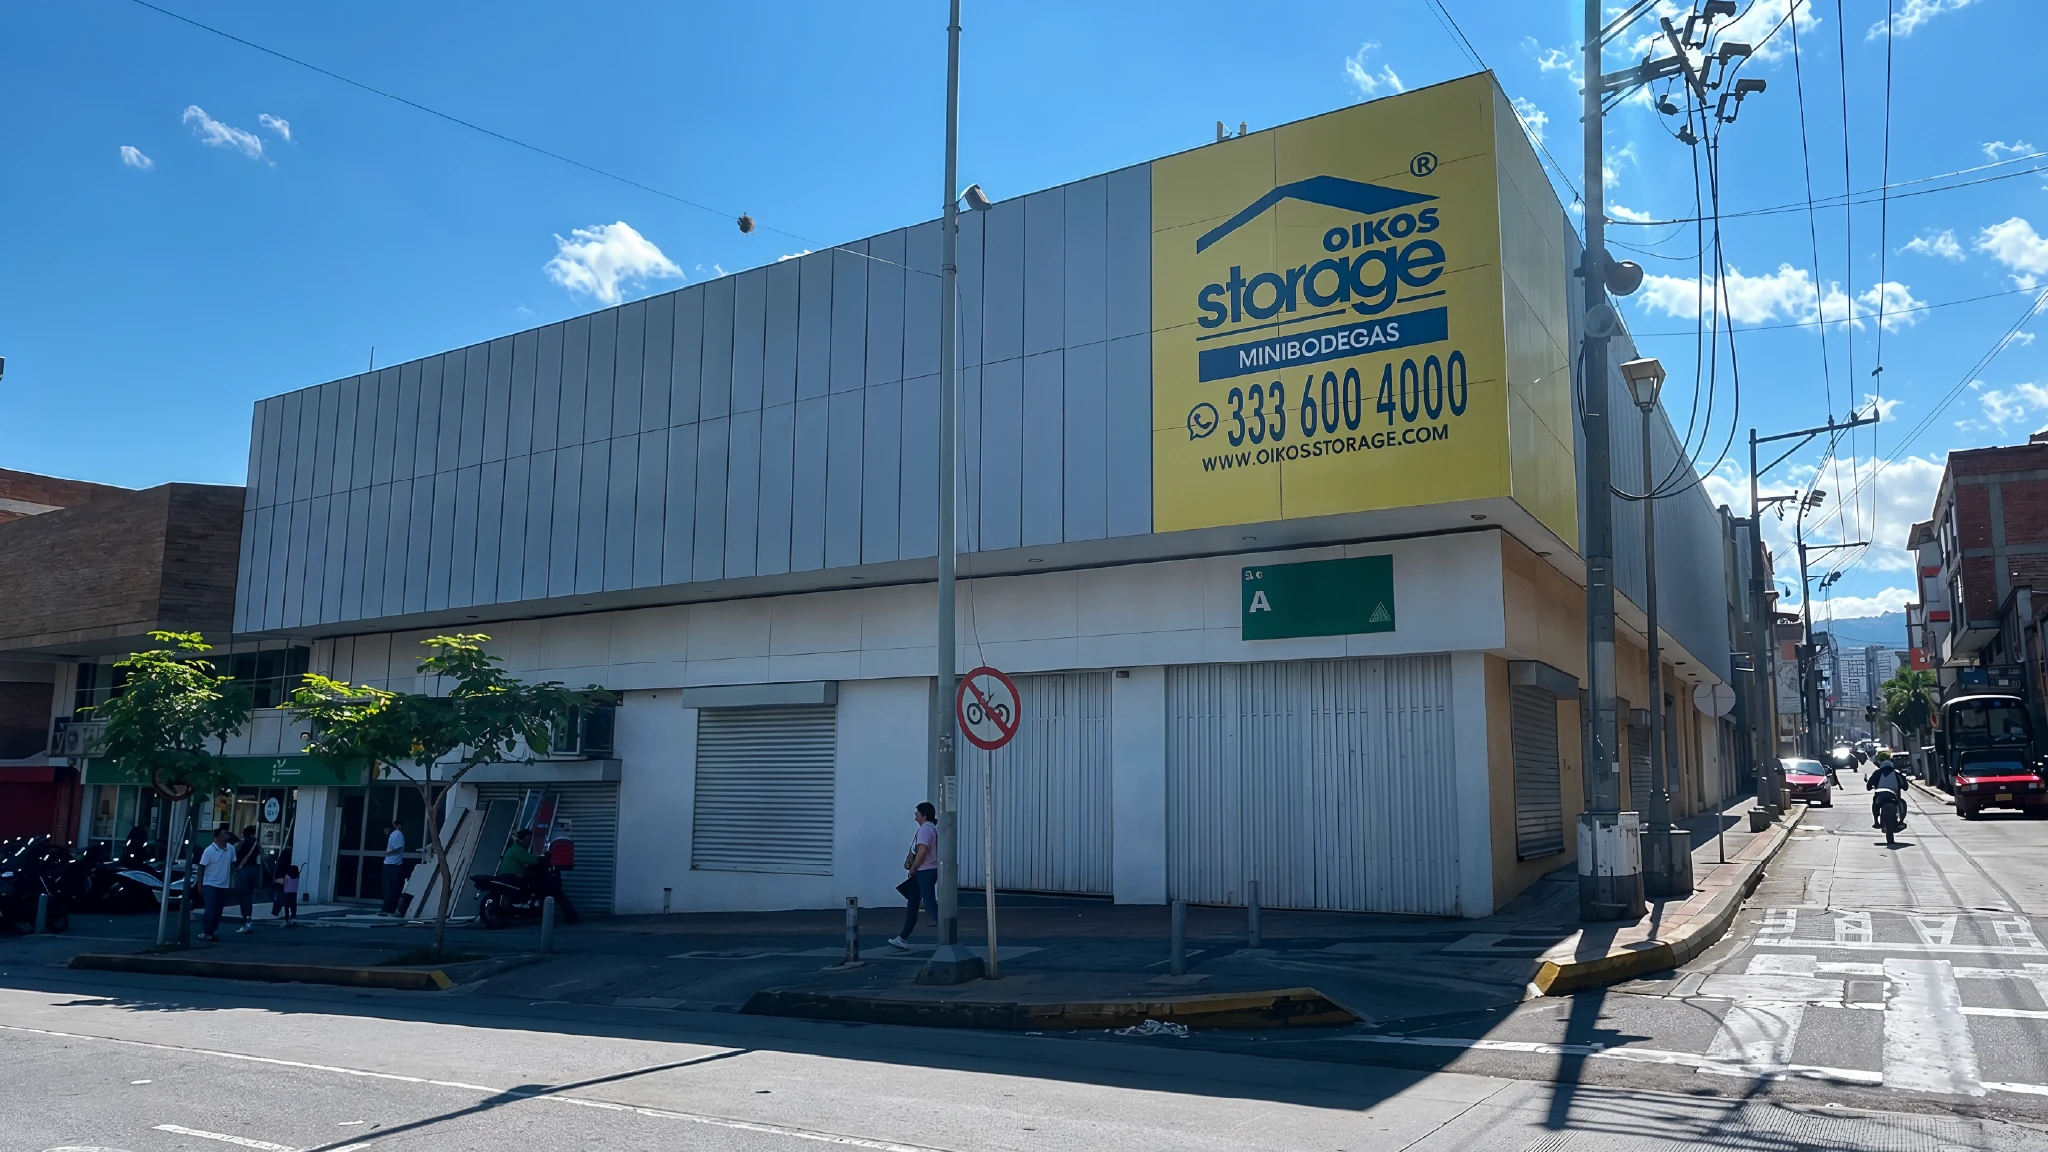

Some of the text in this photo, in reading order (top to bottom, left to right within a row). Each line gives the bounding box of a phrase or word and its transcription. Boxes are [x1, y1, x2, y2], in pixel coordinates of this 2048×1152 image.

[1322, 207, 1440, 252] OIKOS
[1197, 239, 1446, 328] storage
[1239, 323, 1400, 369] MINIBODEGAS
[1227, 350, 1468, 447] 333 600 4000
[1202, 424, 1449, 472] WWW.OIKOSSTORAGE.COM
